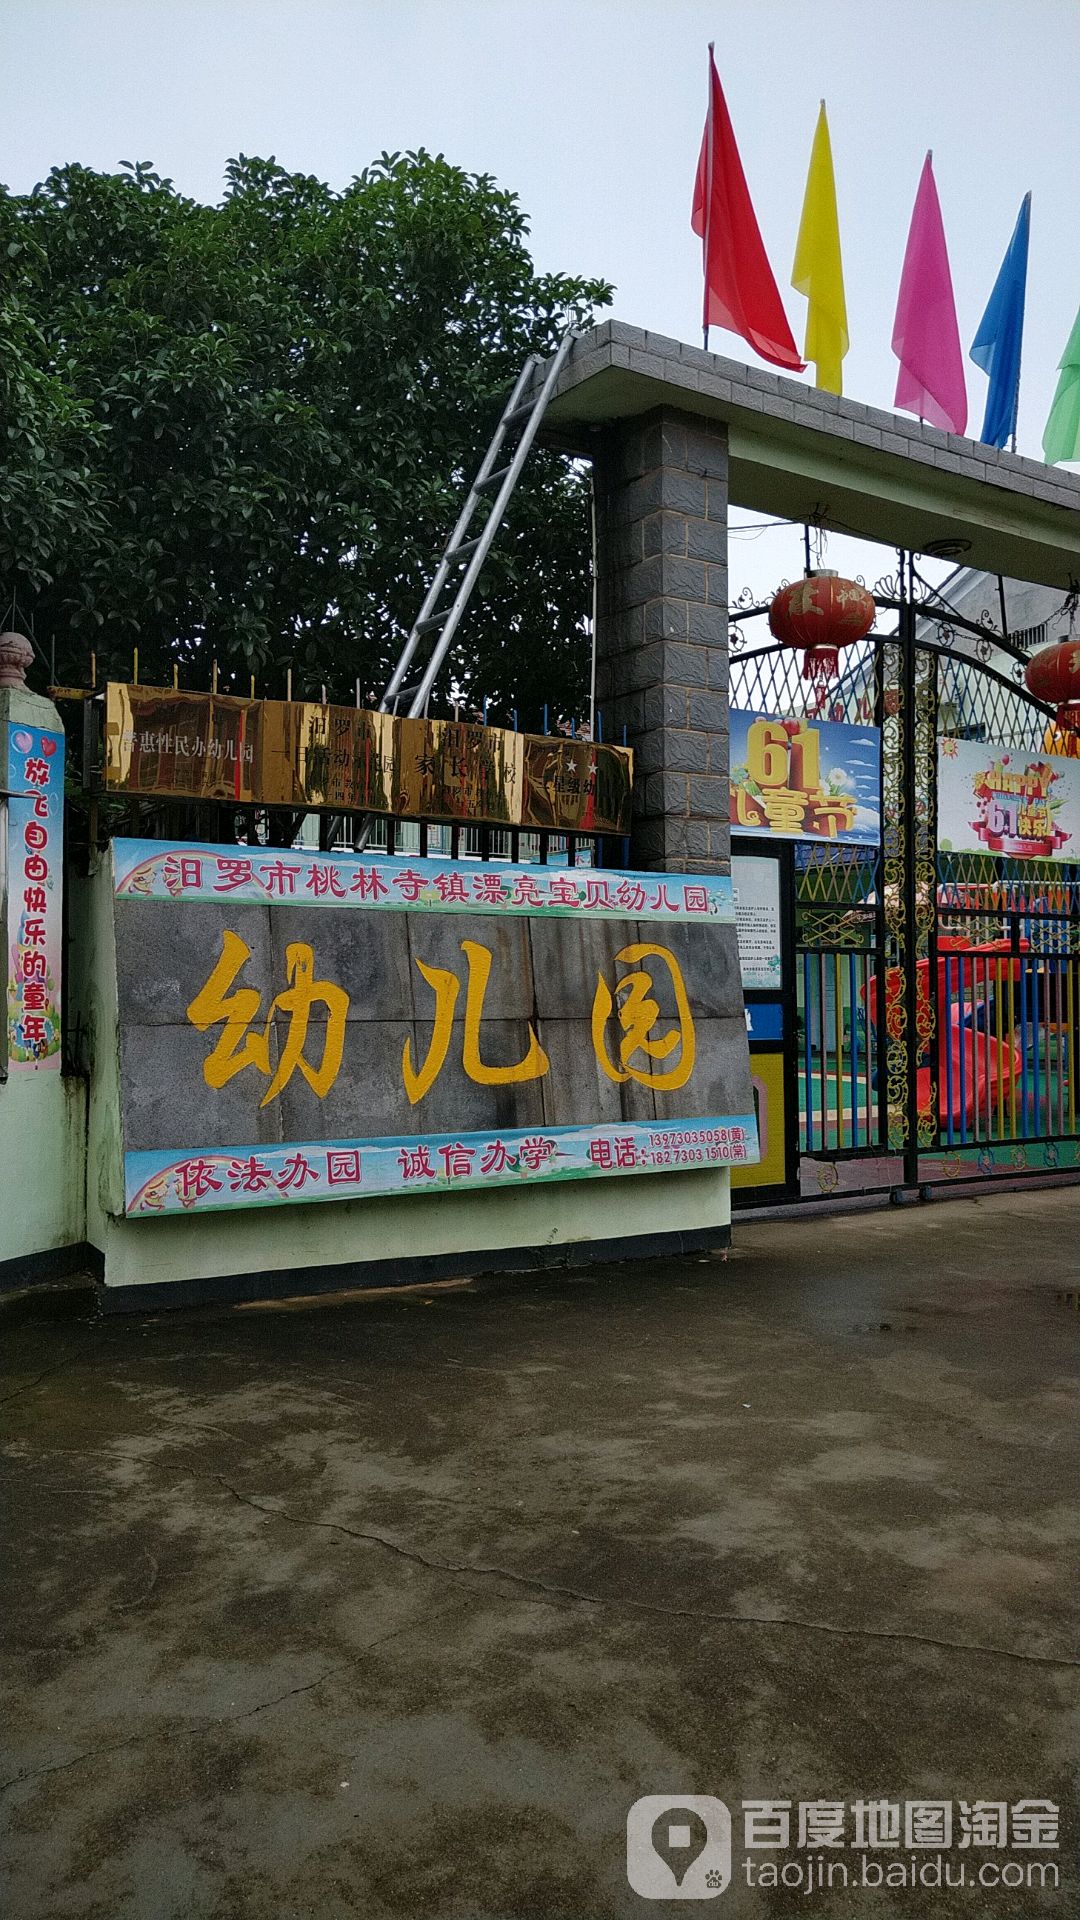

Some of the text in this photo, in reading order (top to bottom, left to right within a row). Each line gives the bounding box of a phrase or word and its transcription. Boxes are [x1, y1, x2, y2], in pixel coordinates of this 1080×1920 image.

[122, 729, 255, 764] 普惠性民办幼儿园
[747, 721, 820, 790] 61
[22, 757, 50, 1042] 放飞自由快乐的童年
[186, 930, 697, 1108] 幼儿园
[174, 1150, 361, 1198] 依法办园
[397, 1136, 553, 1179] 诚信办学
